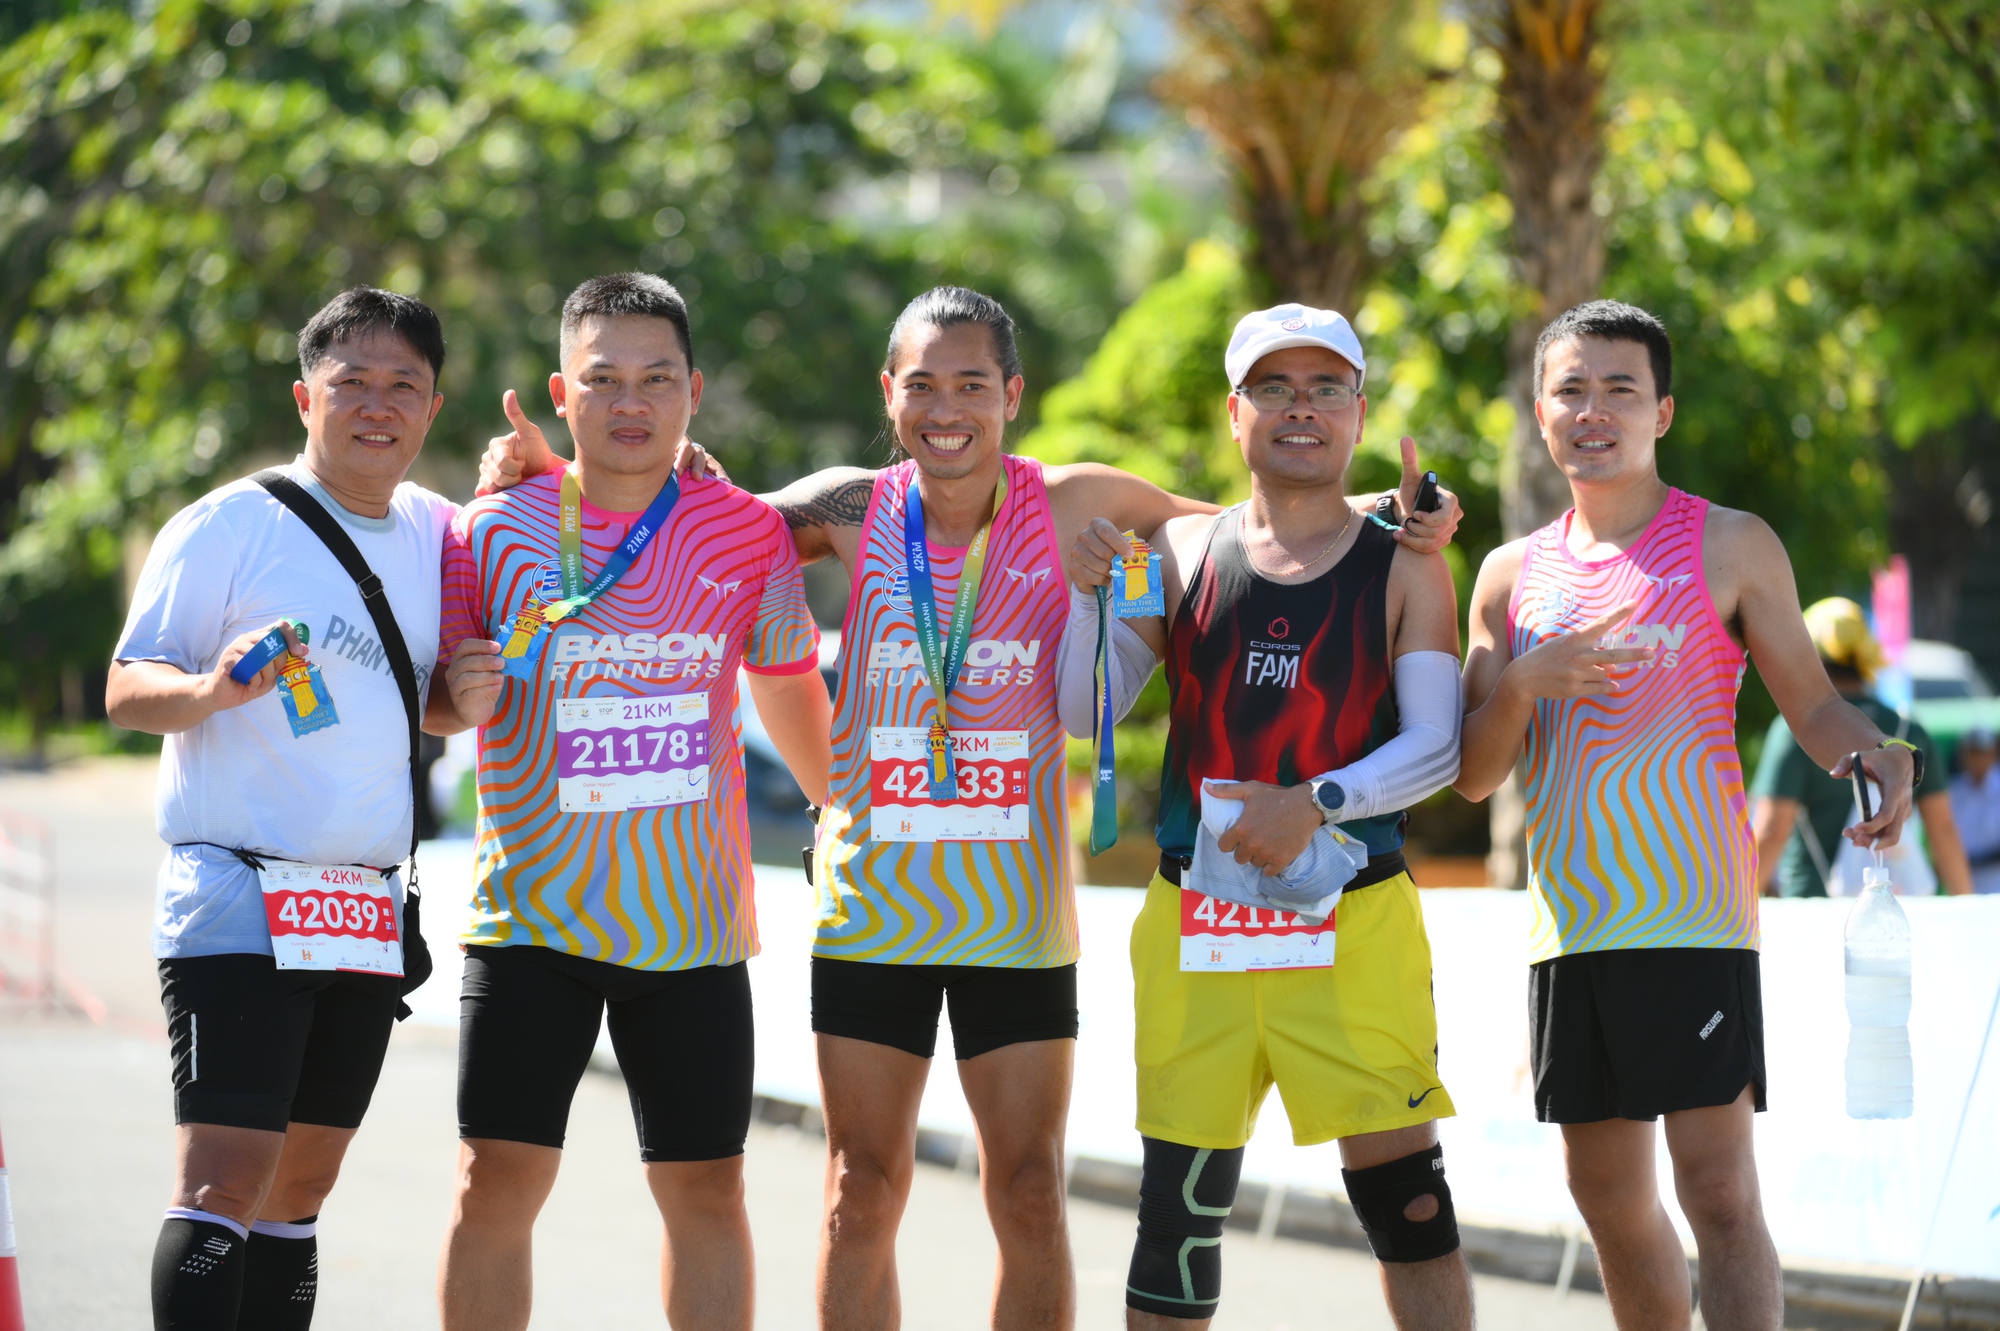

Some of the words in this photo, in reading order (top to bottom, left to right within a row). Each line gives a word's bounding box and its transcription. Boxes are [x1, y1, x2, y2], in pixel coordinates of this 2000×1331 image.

[565, 505, 576, 532] 21KM
[627, 525, 651, 555] 21KM
[567, 553, 577, 578] PHAN
[912, 541, 924, 573] 42KM
[594, 573, 615, 592] XANH
[961, 582, 972, 607] PHAN
[921, 602, 932, 628] XANH
[1117, 600, 1137, 608] PHAN
[1120, 606, 1161, 614] MARATHON
[321, 614, 387, 672] PHAN
[554, 632, 728, 663] BASON
[867, 639, 1041, 668] BAON
[1250, 640, 1301, 651] COROS
[550, 661, 722, 681] RUNNERS
[945, 635, 961, 687] MARATHON
[1245, 651, 1300, 689] FAM
[865, 668, 1035, 688] RUNERS
[623, 702, 672, 720] 21KM
[571, 729, 690, 769] 21178
[951, 737, 989, 752] 2KM
[883, 765, 1005, 799] 4233
[320, 869, 364, 886] 42KM
[278, 896, 379, 932] 42039
[179, 1266, 207, 1276] PORT
[186, 1260, 212, 1271] RESS
[192, 1253, 218, 1265] COMP
